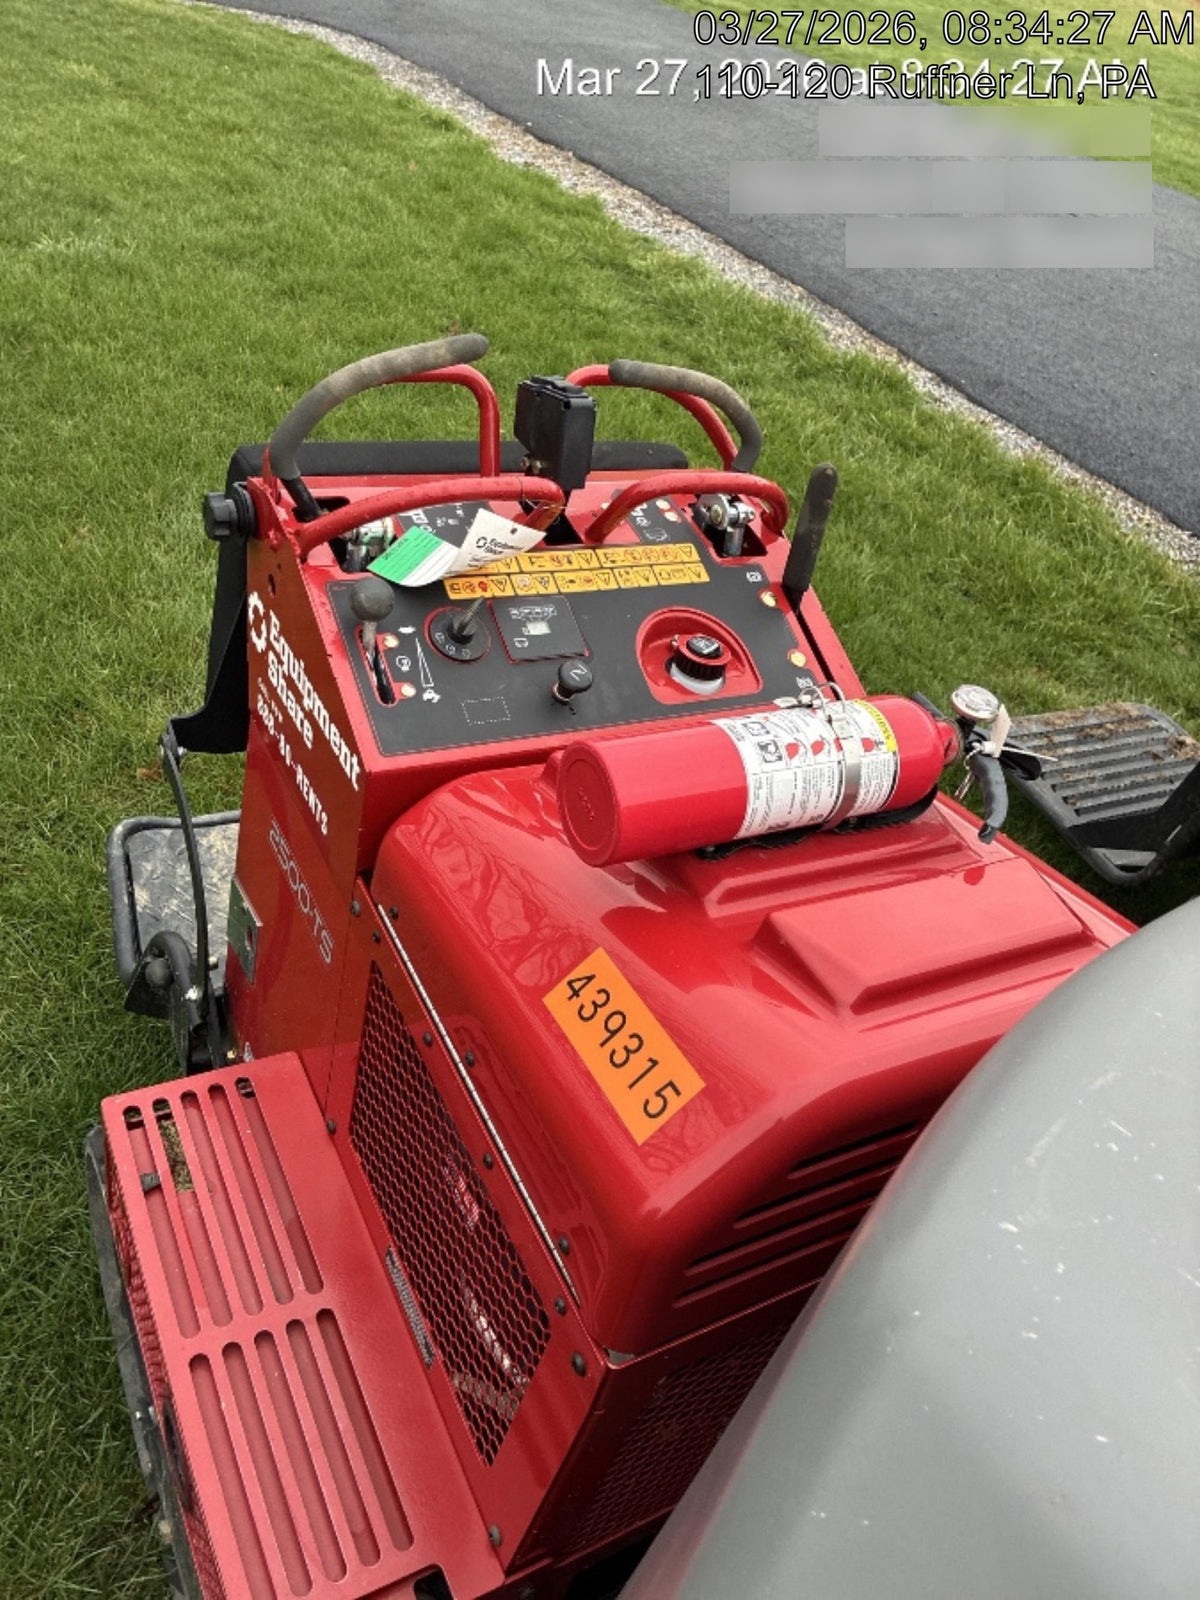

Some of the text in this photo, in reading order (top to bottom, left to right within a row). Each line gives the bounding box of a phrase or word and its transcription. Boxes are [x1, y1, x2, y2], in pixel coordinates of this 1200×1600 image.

[268, 650, 313, 750] Share
[269, 609, 361, 792] Equipment
[566, 973, 682, 1120] 439315
